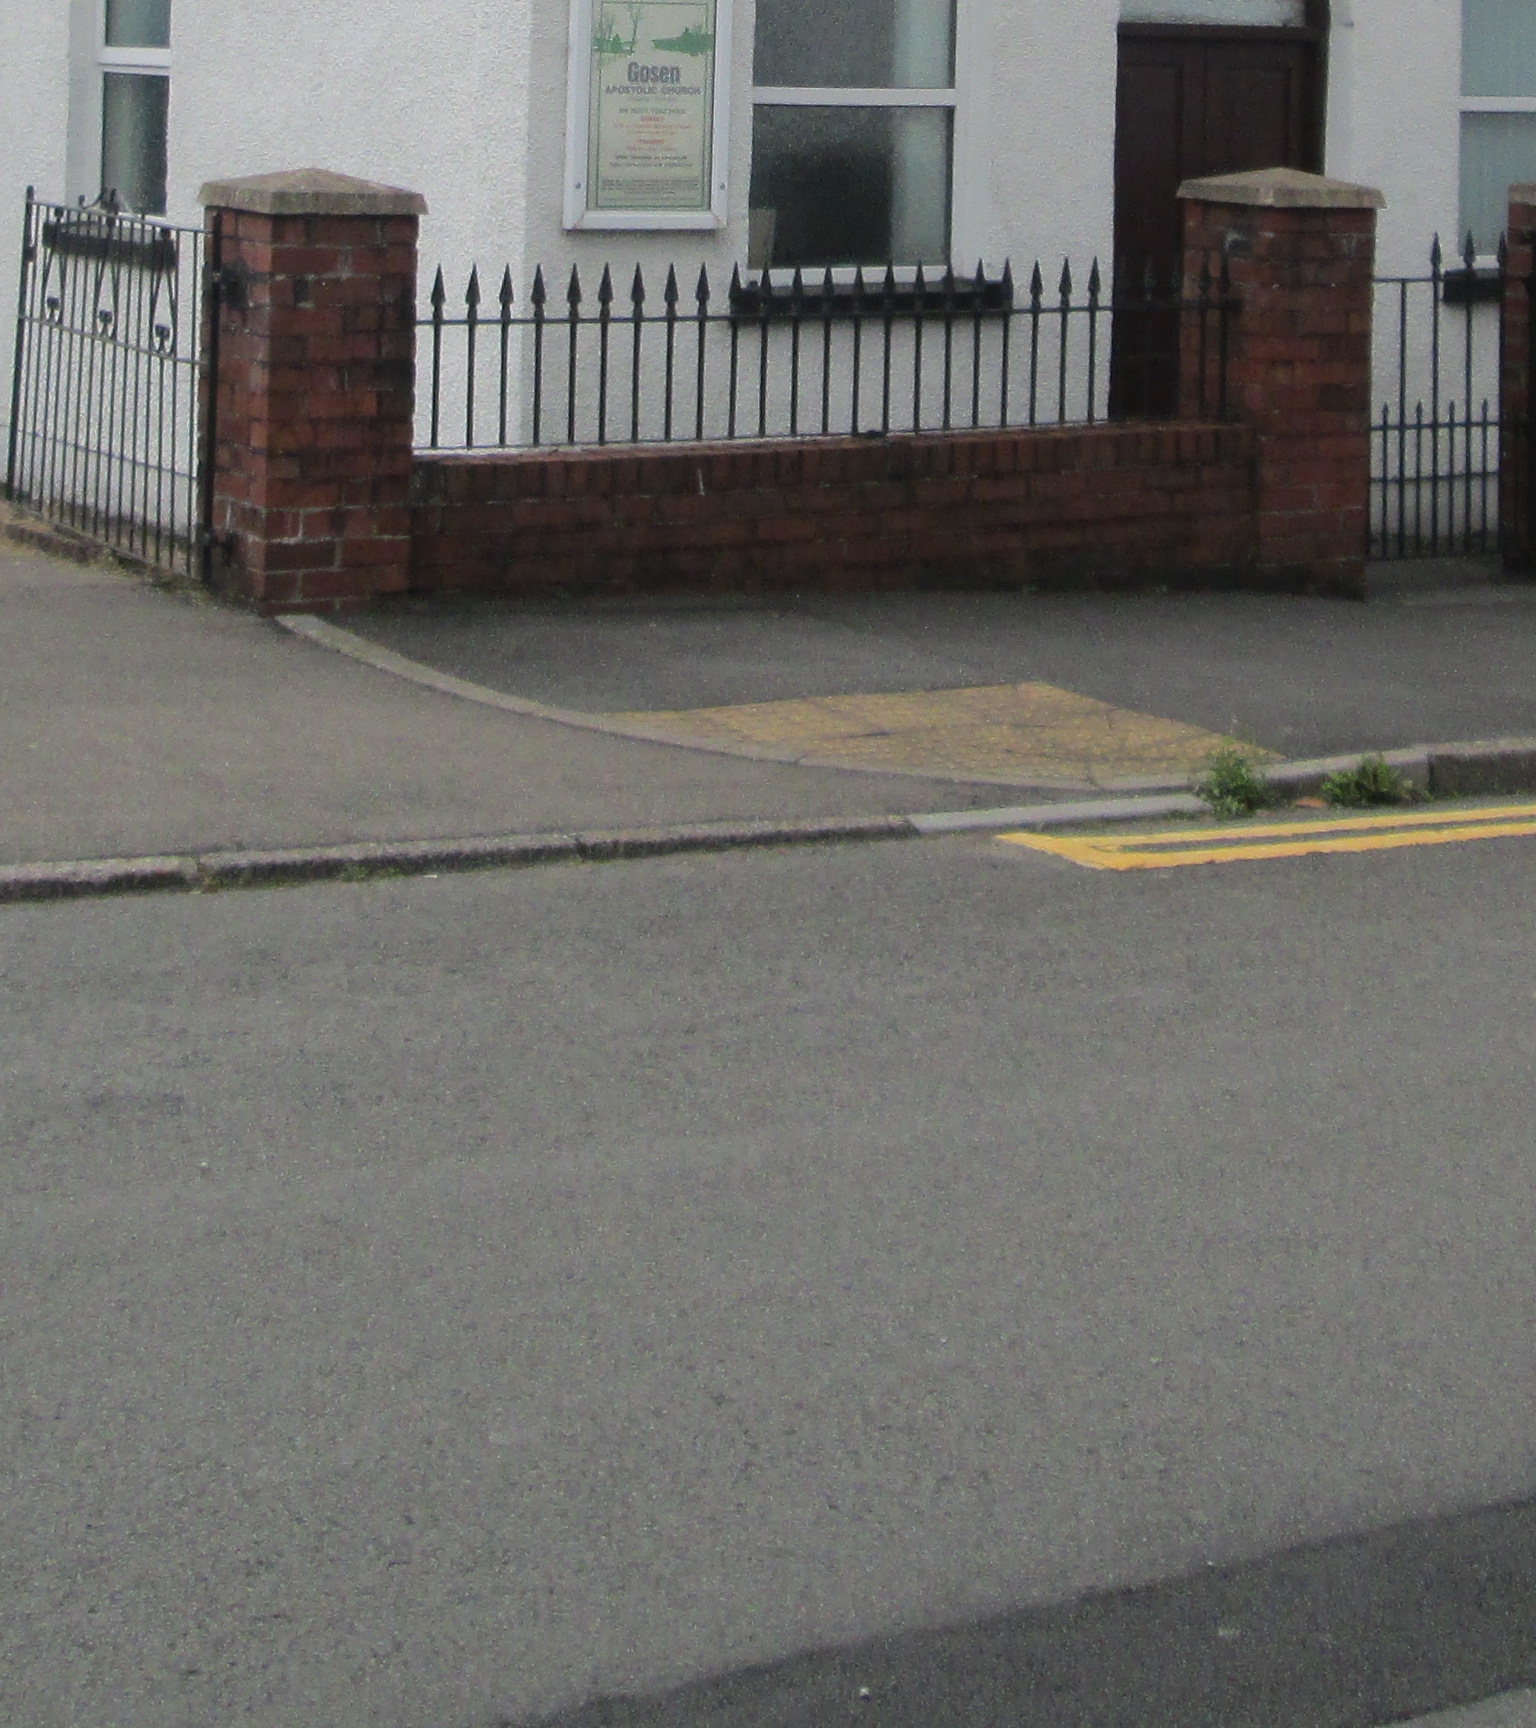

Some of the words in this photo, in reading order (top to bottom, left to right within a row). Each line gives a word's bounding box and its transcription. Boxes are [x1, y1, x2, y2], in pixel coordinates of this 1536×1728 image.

[627, 61, 680, 84] Gosen
[605, 84, 657, 95] APOSTOLIC
[662, 85, 702, 96] CHURCH
